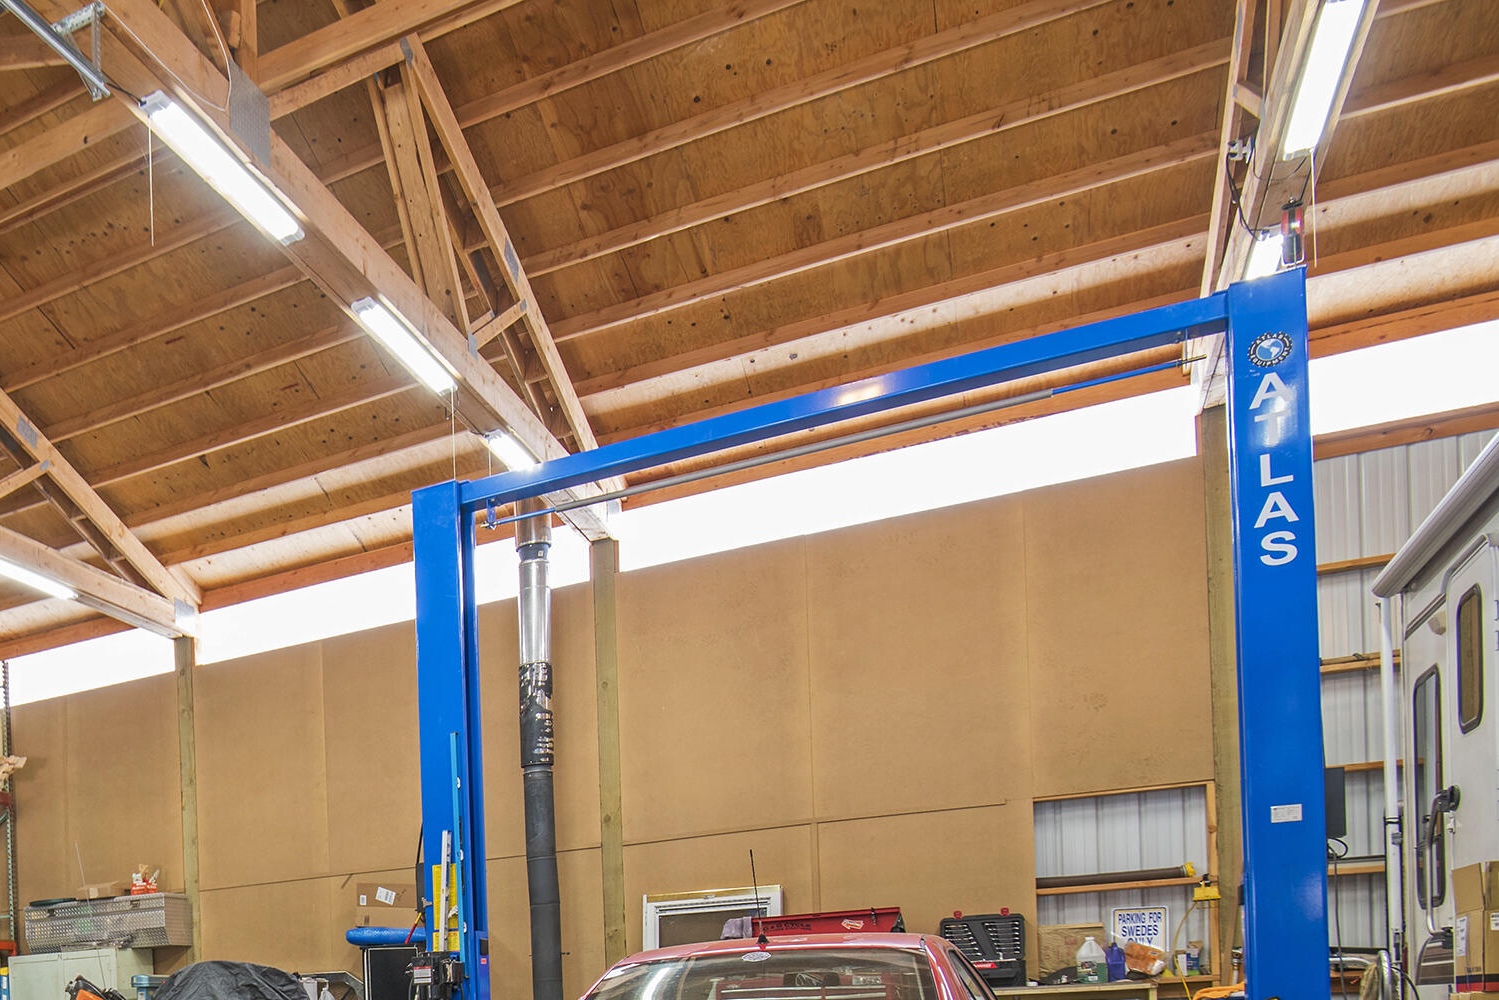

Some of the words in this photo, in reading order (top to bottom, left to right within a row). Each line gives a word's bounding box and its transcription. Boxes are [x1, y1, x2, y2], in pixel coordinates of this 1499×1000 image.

[1248, 371, 1300, 567] ATLAS
[1118, 912, 1146, 924] PARKING
[1148, 911, 1162, 923] FOR
[1121, 925, 1159, 937] SWEDES
